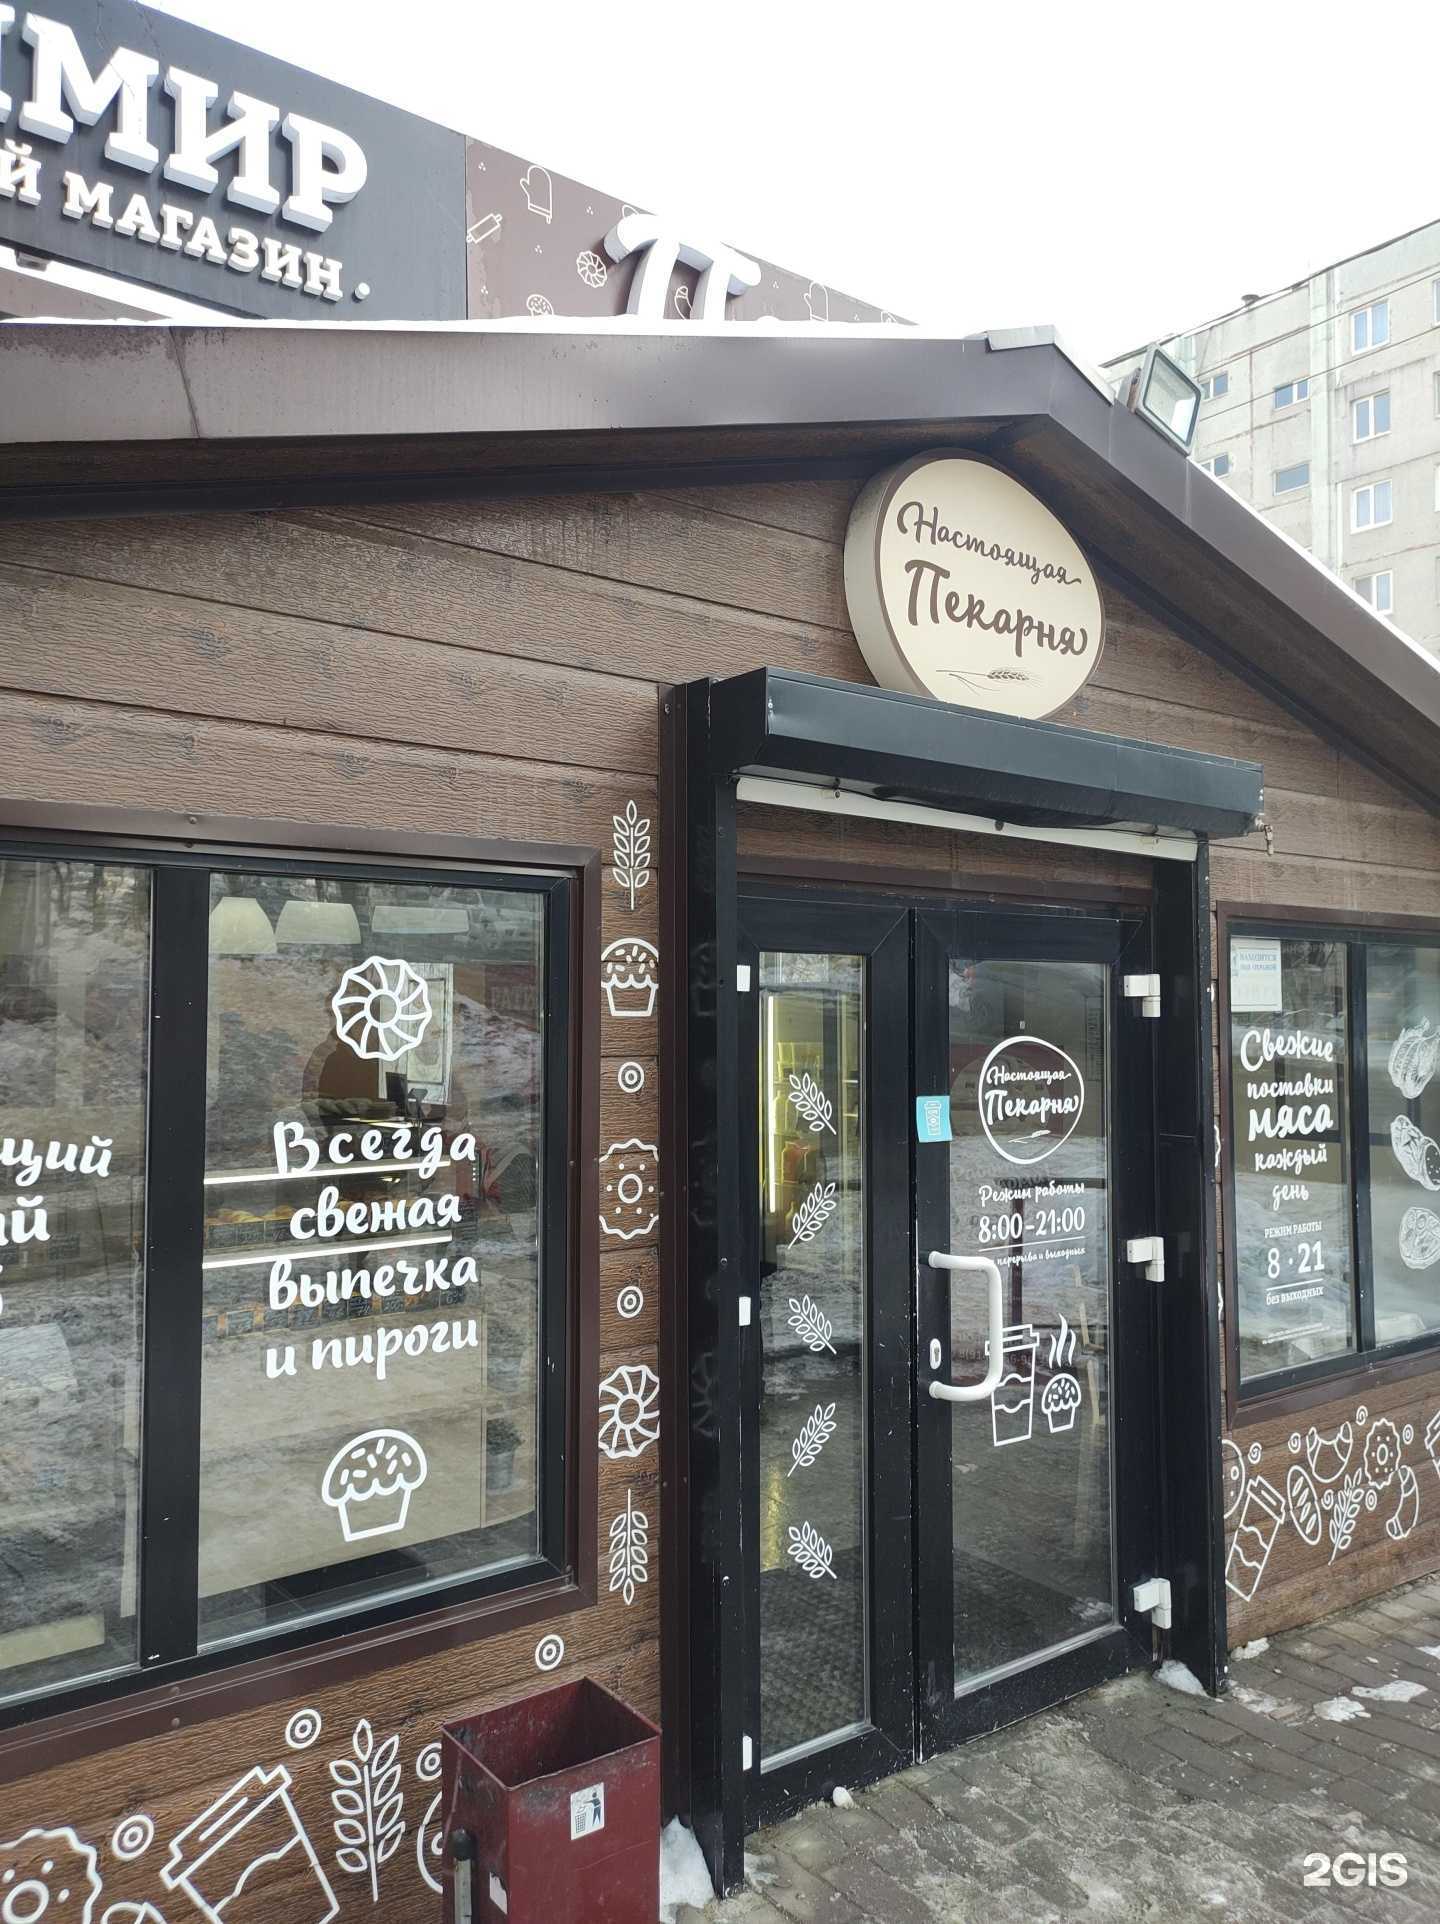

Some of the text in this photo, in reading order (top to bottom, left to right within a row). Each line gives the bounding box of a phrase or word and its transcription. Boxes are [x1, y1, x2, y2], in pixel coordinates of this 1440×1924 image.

[0, 3, 367, 232] МИР
[896, 501, 1082, 585] Настоящая
[904, 559, 1088, 658] Пекарня
[1240, 1028, 1334, 1072] Свежие
[986, 1065, 1072, 1086] Настоящая
[1247, 1072, 1334, 1099] поставки
[984, 1089, 1080, 1126] Пекарня
[273, 1121, 477, 1180] Всегда
[1255, 1143, 1328, 1175] каждый
[290, 1185, 462, 1240] свежая
[978, 1185, 1032, 1208] Режим
[1035, 1180, 1085, 1203] работы
[1272, 1183, 1310, 1212] день
[0, 1195, 51, 1247] й
[1264, 1221, 1322, 1239] РЕЖИМ РАБОТЫ
[1045, 1247, 1086, 1261] выходных
[269, 1256, 479, 1310] выпечка
[266, 1319, 479, 1380] и пироги
